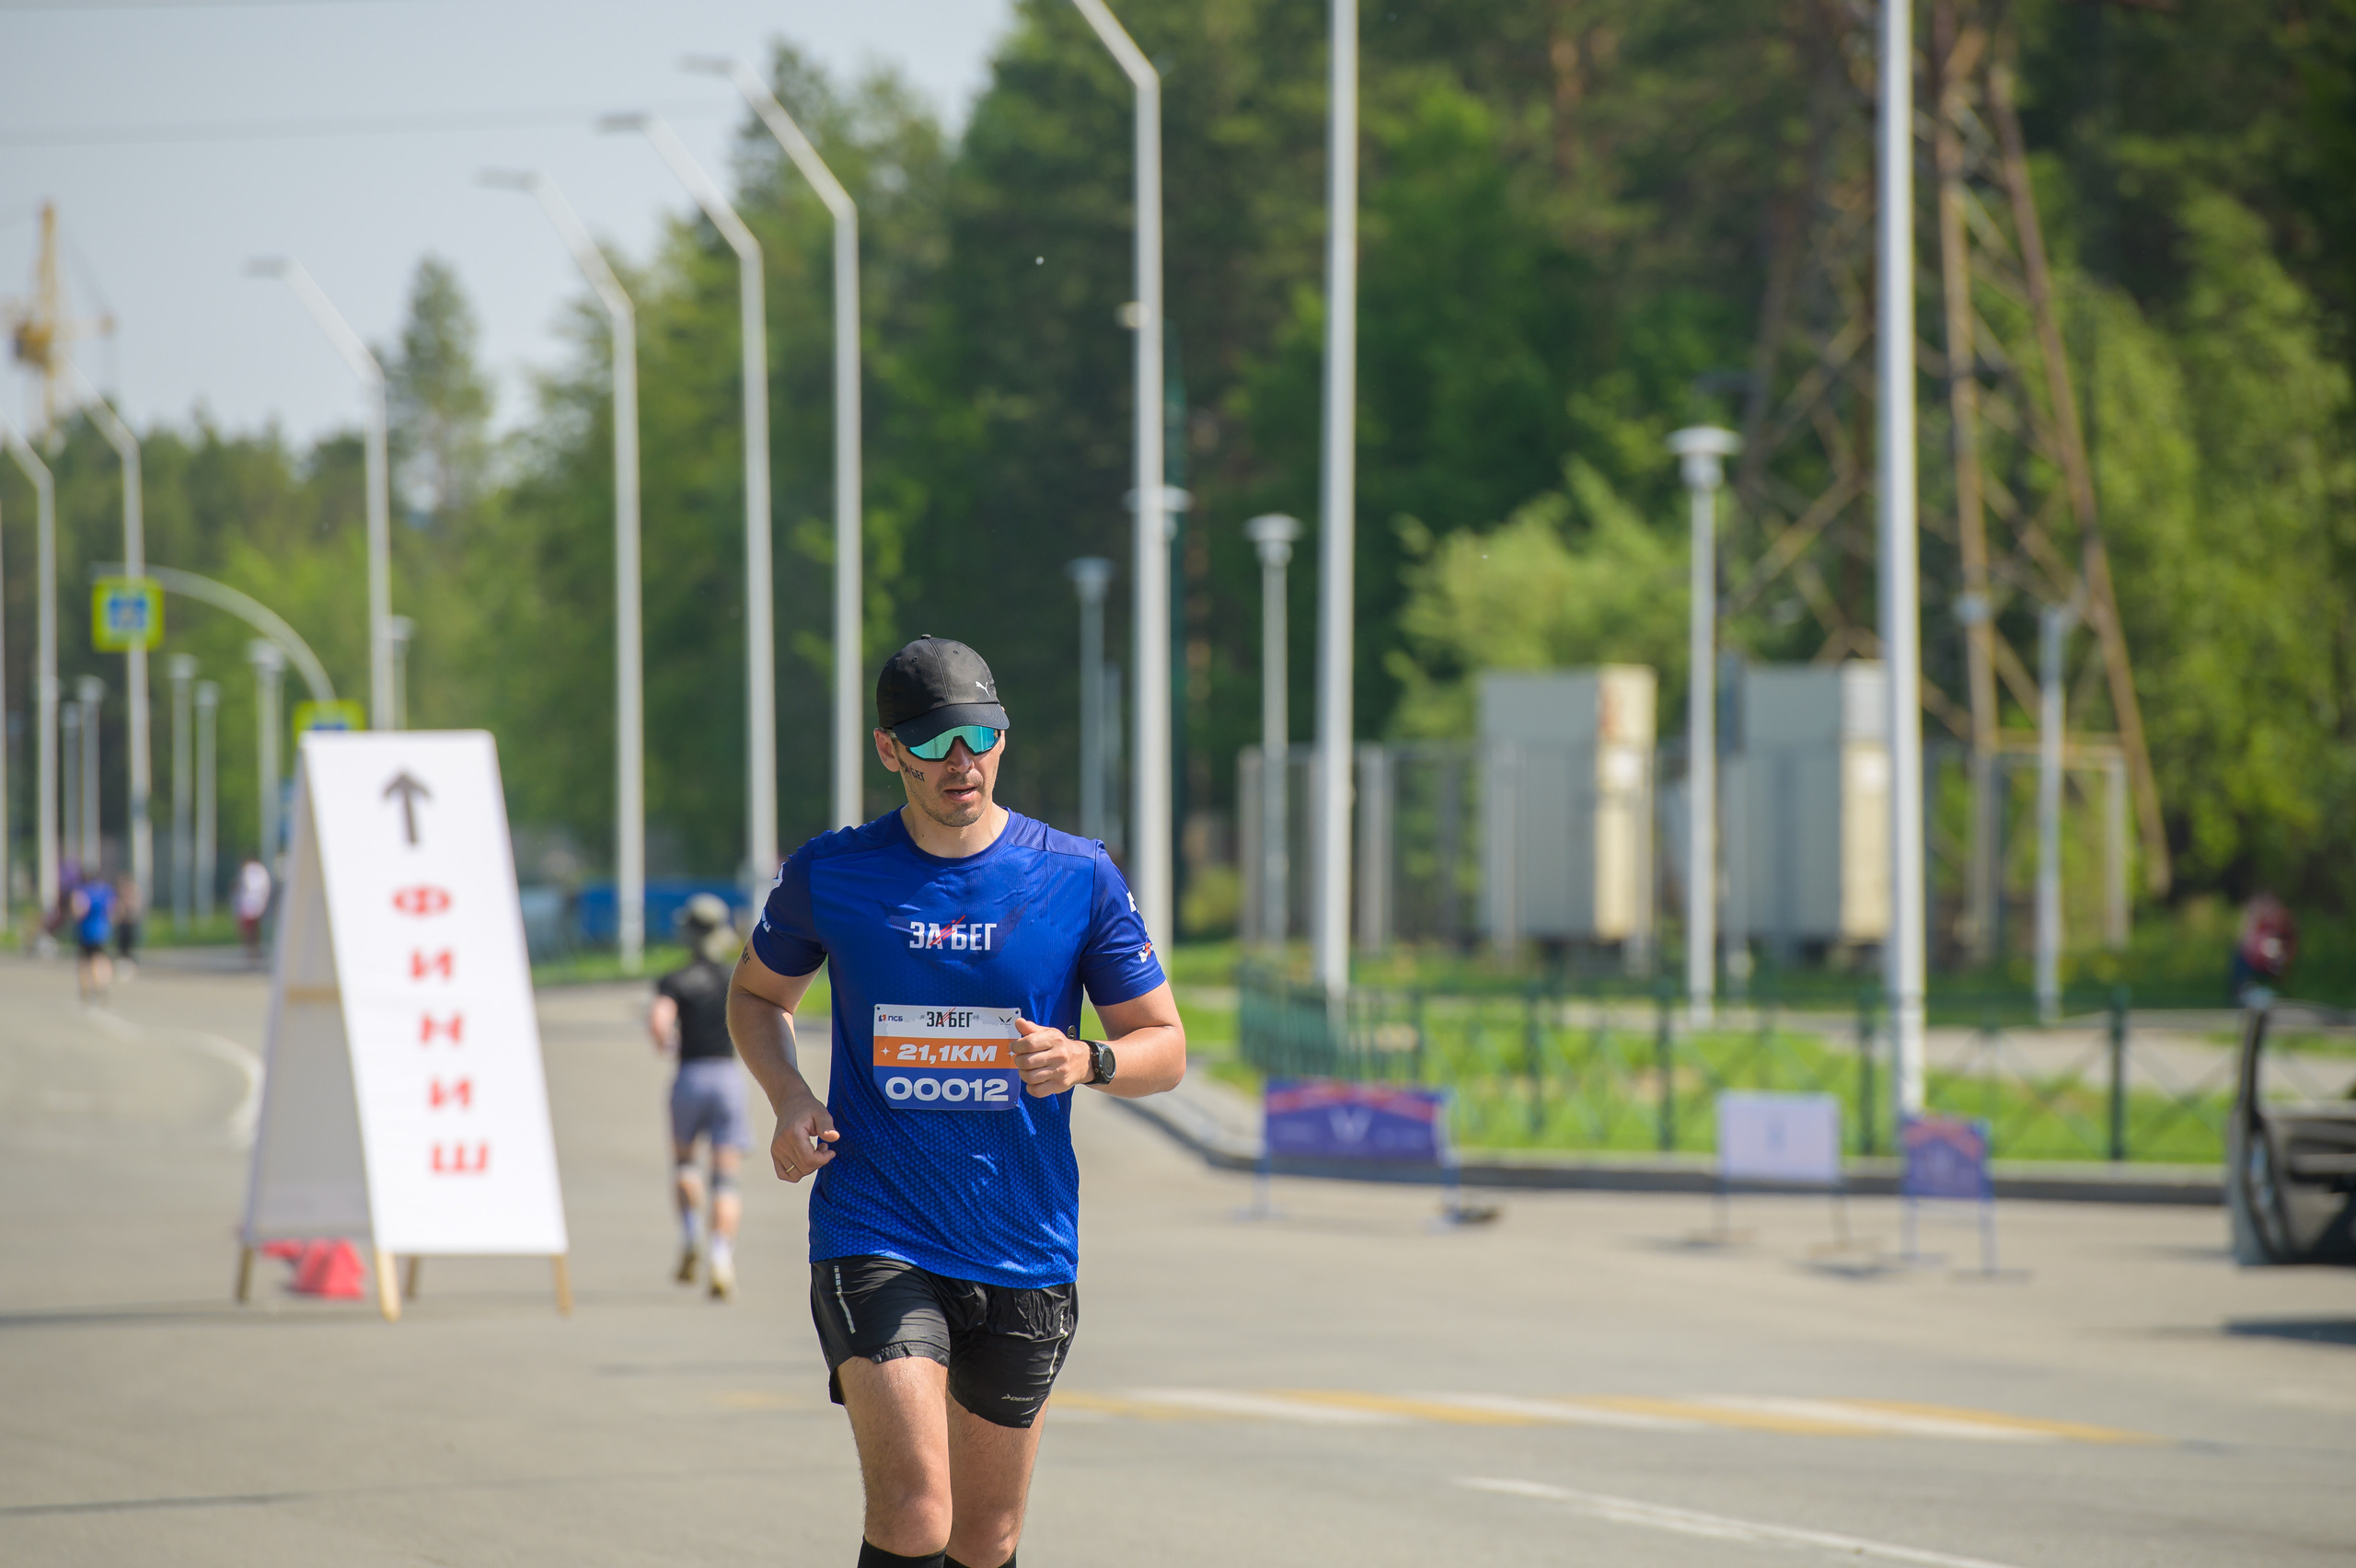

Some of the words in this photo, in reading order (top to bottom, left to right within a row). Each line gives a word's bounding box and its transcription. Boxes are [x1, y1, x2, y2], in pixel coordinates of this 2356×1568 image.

[391, 885, 491, 1177] ФИНИШ
[896, 1043, 998, 1065] 21,1КМ
[884, 1076, 1009, 1102] 00012
